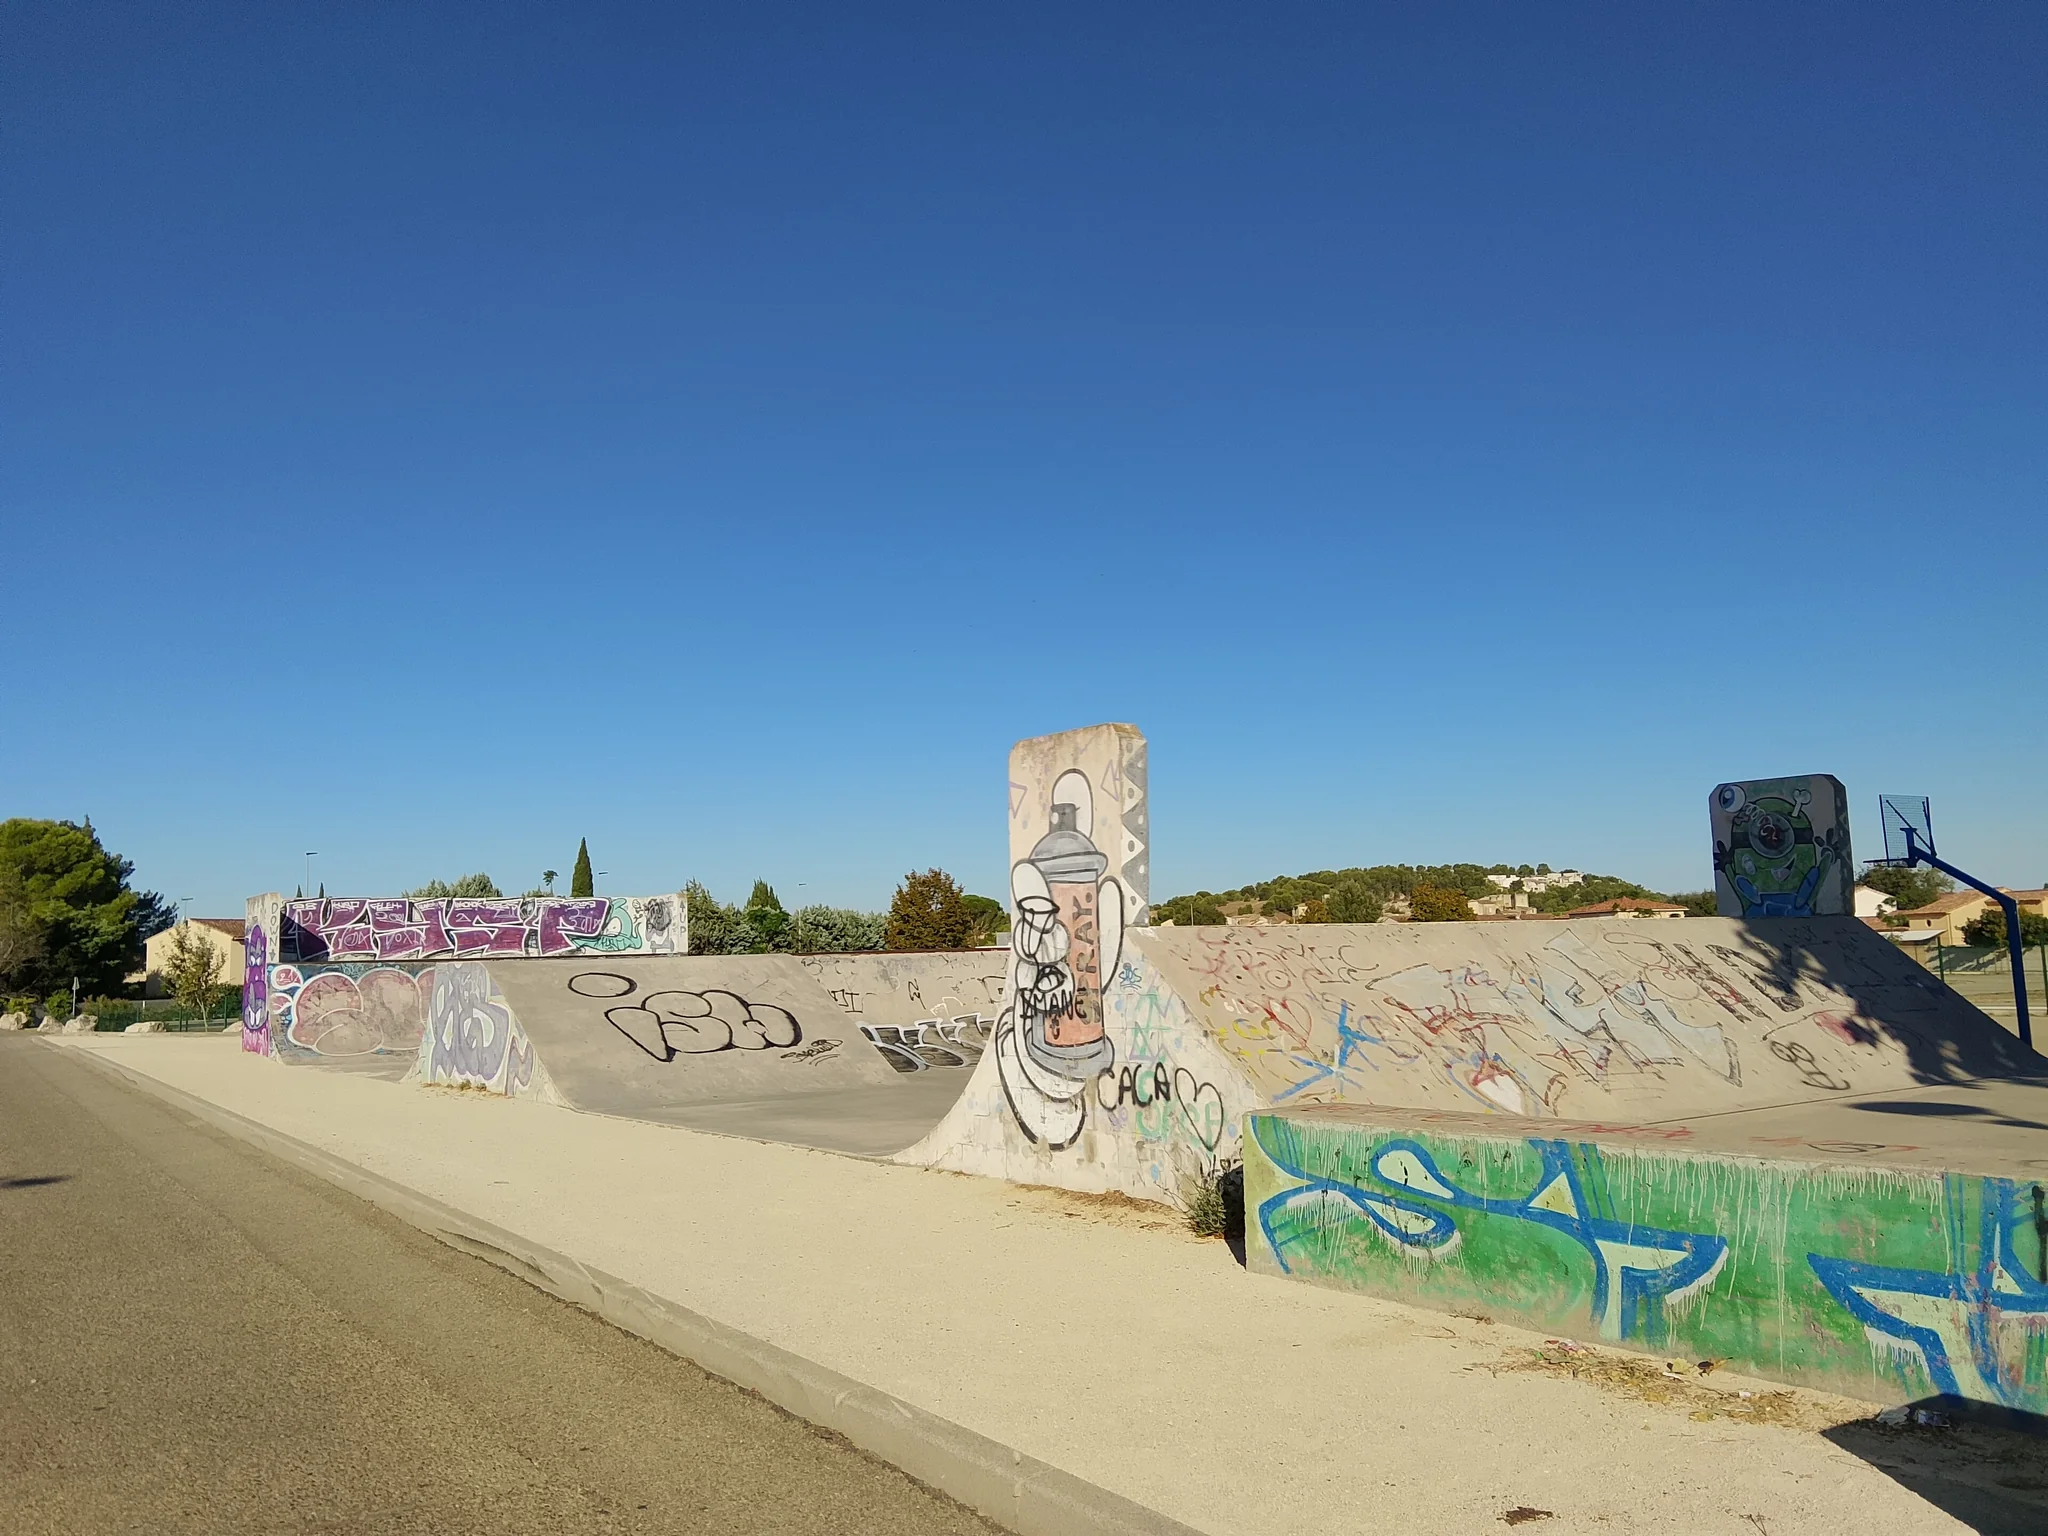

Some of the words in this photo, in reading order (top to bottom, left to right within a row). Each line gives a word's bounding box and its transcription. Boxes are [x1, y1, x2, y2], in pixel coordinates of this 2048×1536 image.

[269, 902, 279, 947] DOWN
[679, 913, 687, 934] UP
[1097, 1061, 1171, 1112] CACA
